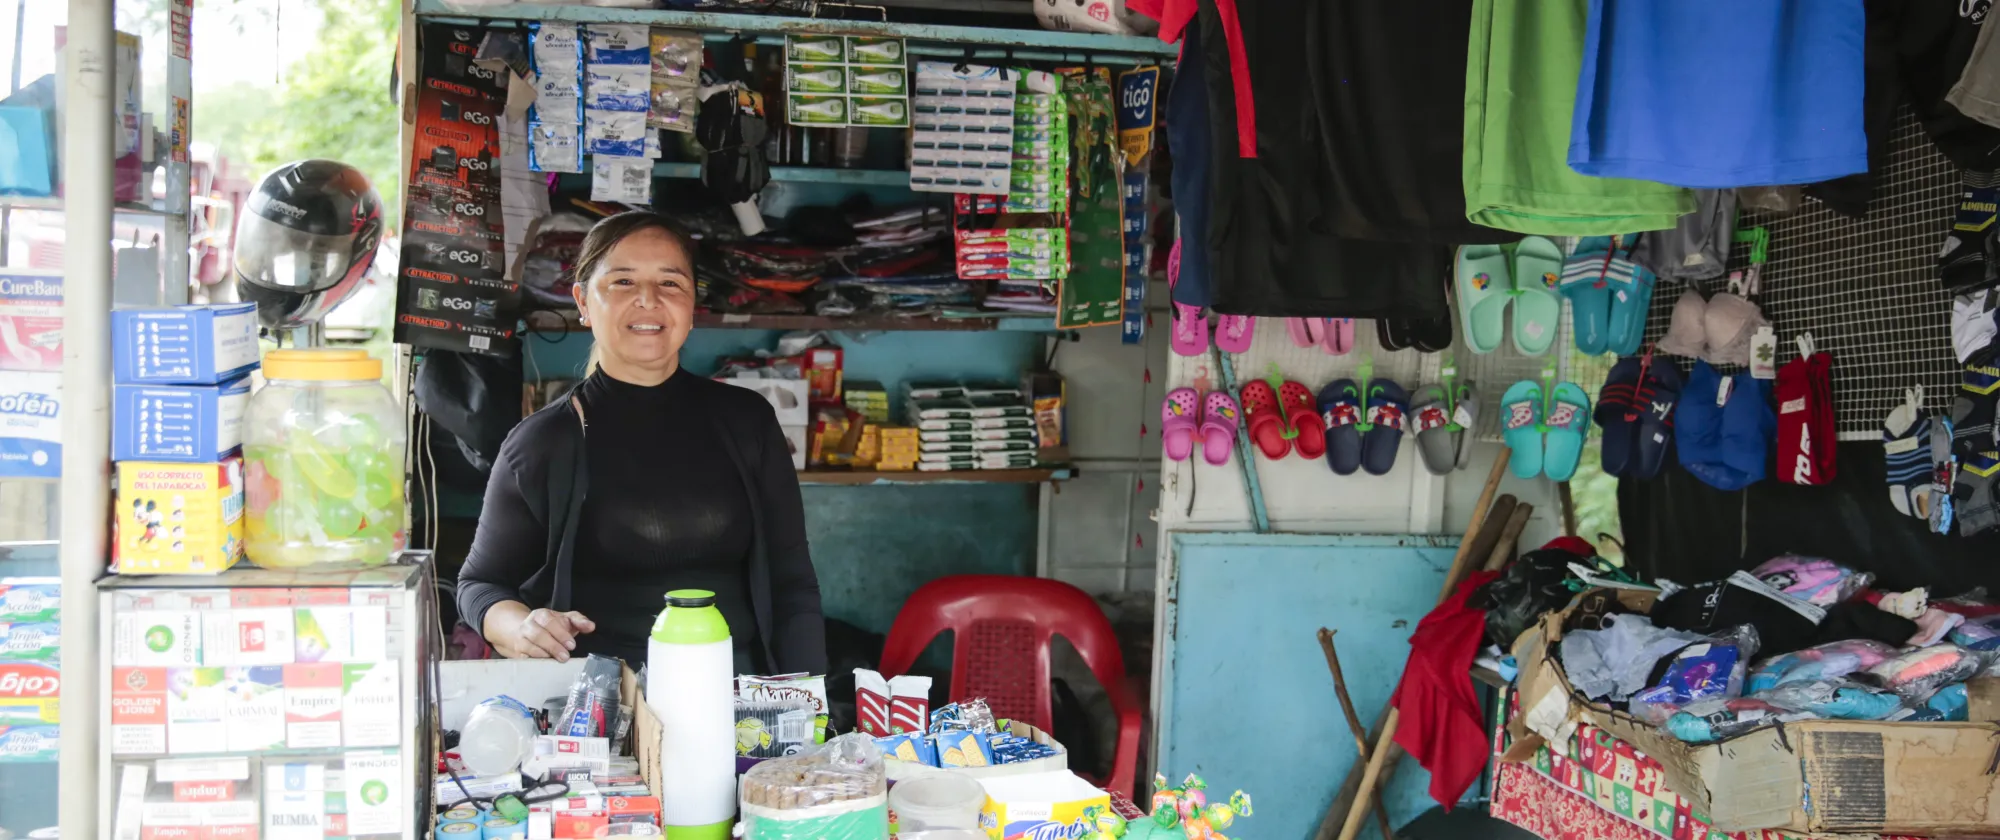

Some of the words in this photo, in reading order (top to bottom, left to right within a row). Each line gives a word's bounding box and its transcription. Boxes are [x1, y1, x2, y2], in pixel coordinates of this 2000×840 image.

[467, 64, 493, 79] eGo
[432, 80, 471, 95] ATTRACTION
[463, 111, 490, 125] eGo
[459, 157, 487, 171] eGo
[422, 176, 463, 189] ATTRACTION
[455, 203, 484, 216] eGo
[416, 221, 459, 234] ATTRACTION
[449, 250, 479, 263] eGo
[410, 270, 452, 282] ATTRACTION
[442, 298, 472, 310] eGo
[404, 316, 445, 328] ATTRACTION
[137, 471, 154, 479] USO
[157, 471, 203, 480] CORRECTO
[134, 481, 149, 489] DEL
[152, 481, 207, 490] TAPABOCAS
[13, 630, 43, 642] Triple
[1, 672, 60, 695] Colg
[112, 698, 162, 706] GOLDEN
[290, 694, 336, 708] Empire
[119, 706, 155, 714] LIONS
[11, 733, 41, 744] Triple
[568, 772, 589, 781] LUCKY
[180, 784, 226, 798] Empire
[272, 813, 319, 826] RUMBA
[154, 827, 188, 836] Empire
[212, 825, 247, 835] Empire
